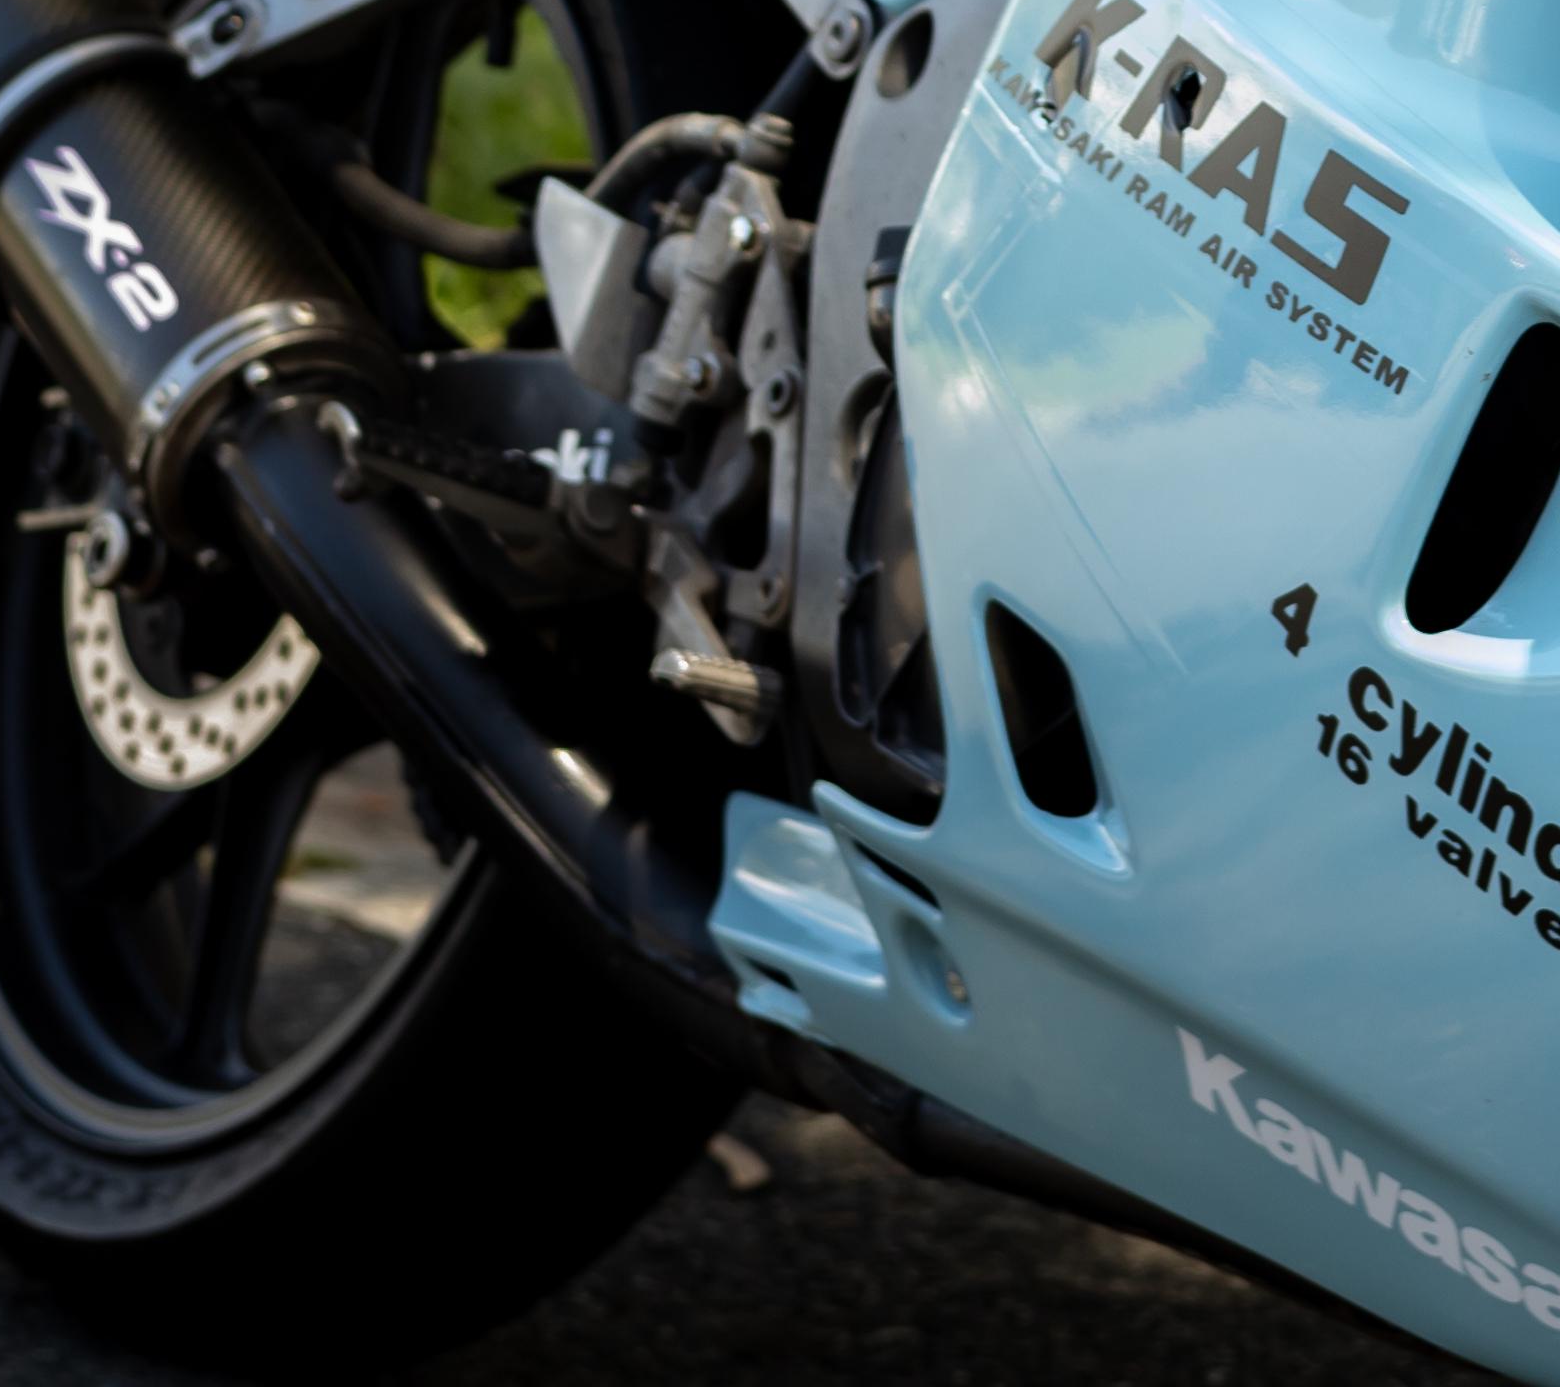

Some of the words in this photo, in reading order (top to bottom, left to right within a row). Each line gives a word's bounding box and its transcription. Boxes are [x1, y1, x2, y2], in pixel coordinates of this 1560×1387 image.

[987, 53, 1125, 183] KAWSAKI
[1124, 170, 1197, 239] RAM
[1199, 234, 1258, 289] AIR
[1265, 280, 1411, 395] SYSTEM
[1270, 582, 1319, 658] 4
[1315, 713, 1374, 786] 16
